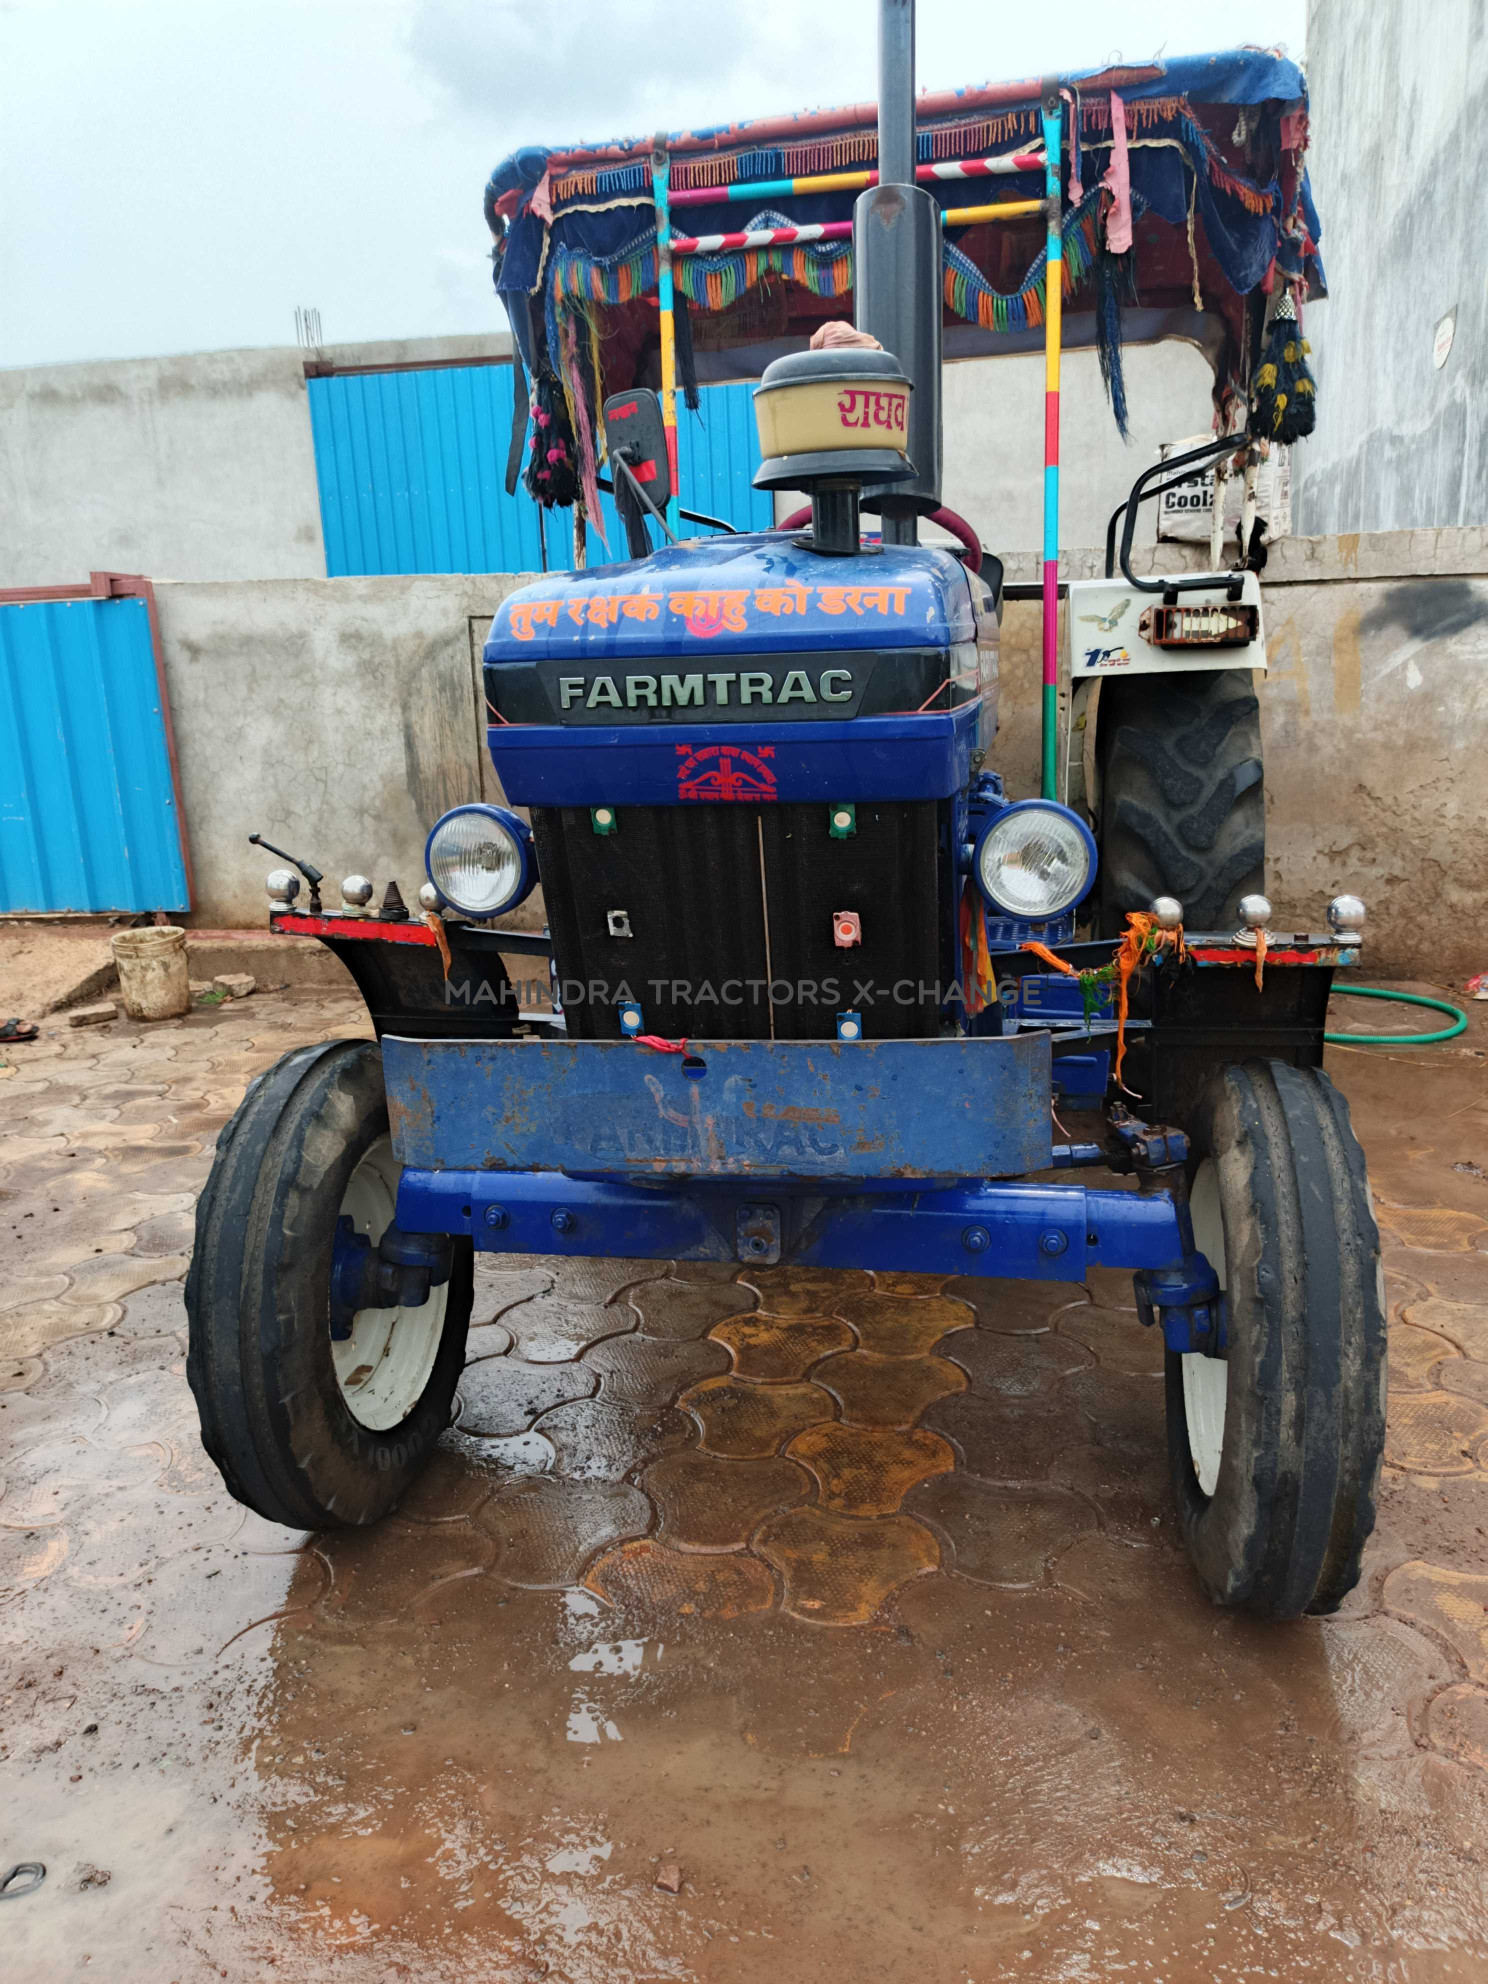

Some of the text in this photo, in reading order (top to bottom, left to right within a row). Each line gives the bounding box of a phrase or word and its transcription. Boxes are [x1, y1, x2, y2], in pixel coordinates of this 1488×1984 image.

[837, 389, 906, 431] राघव
[509, 600, 564, 641] तुम
[568, 593, 664, 628] रक्षक
[754, 579, 814, 616] को
[816, 586, 912, 616] डरना
[559, 669, 853, 709] FARMTRAC
